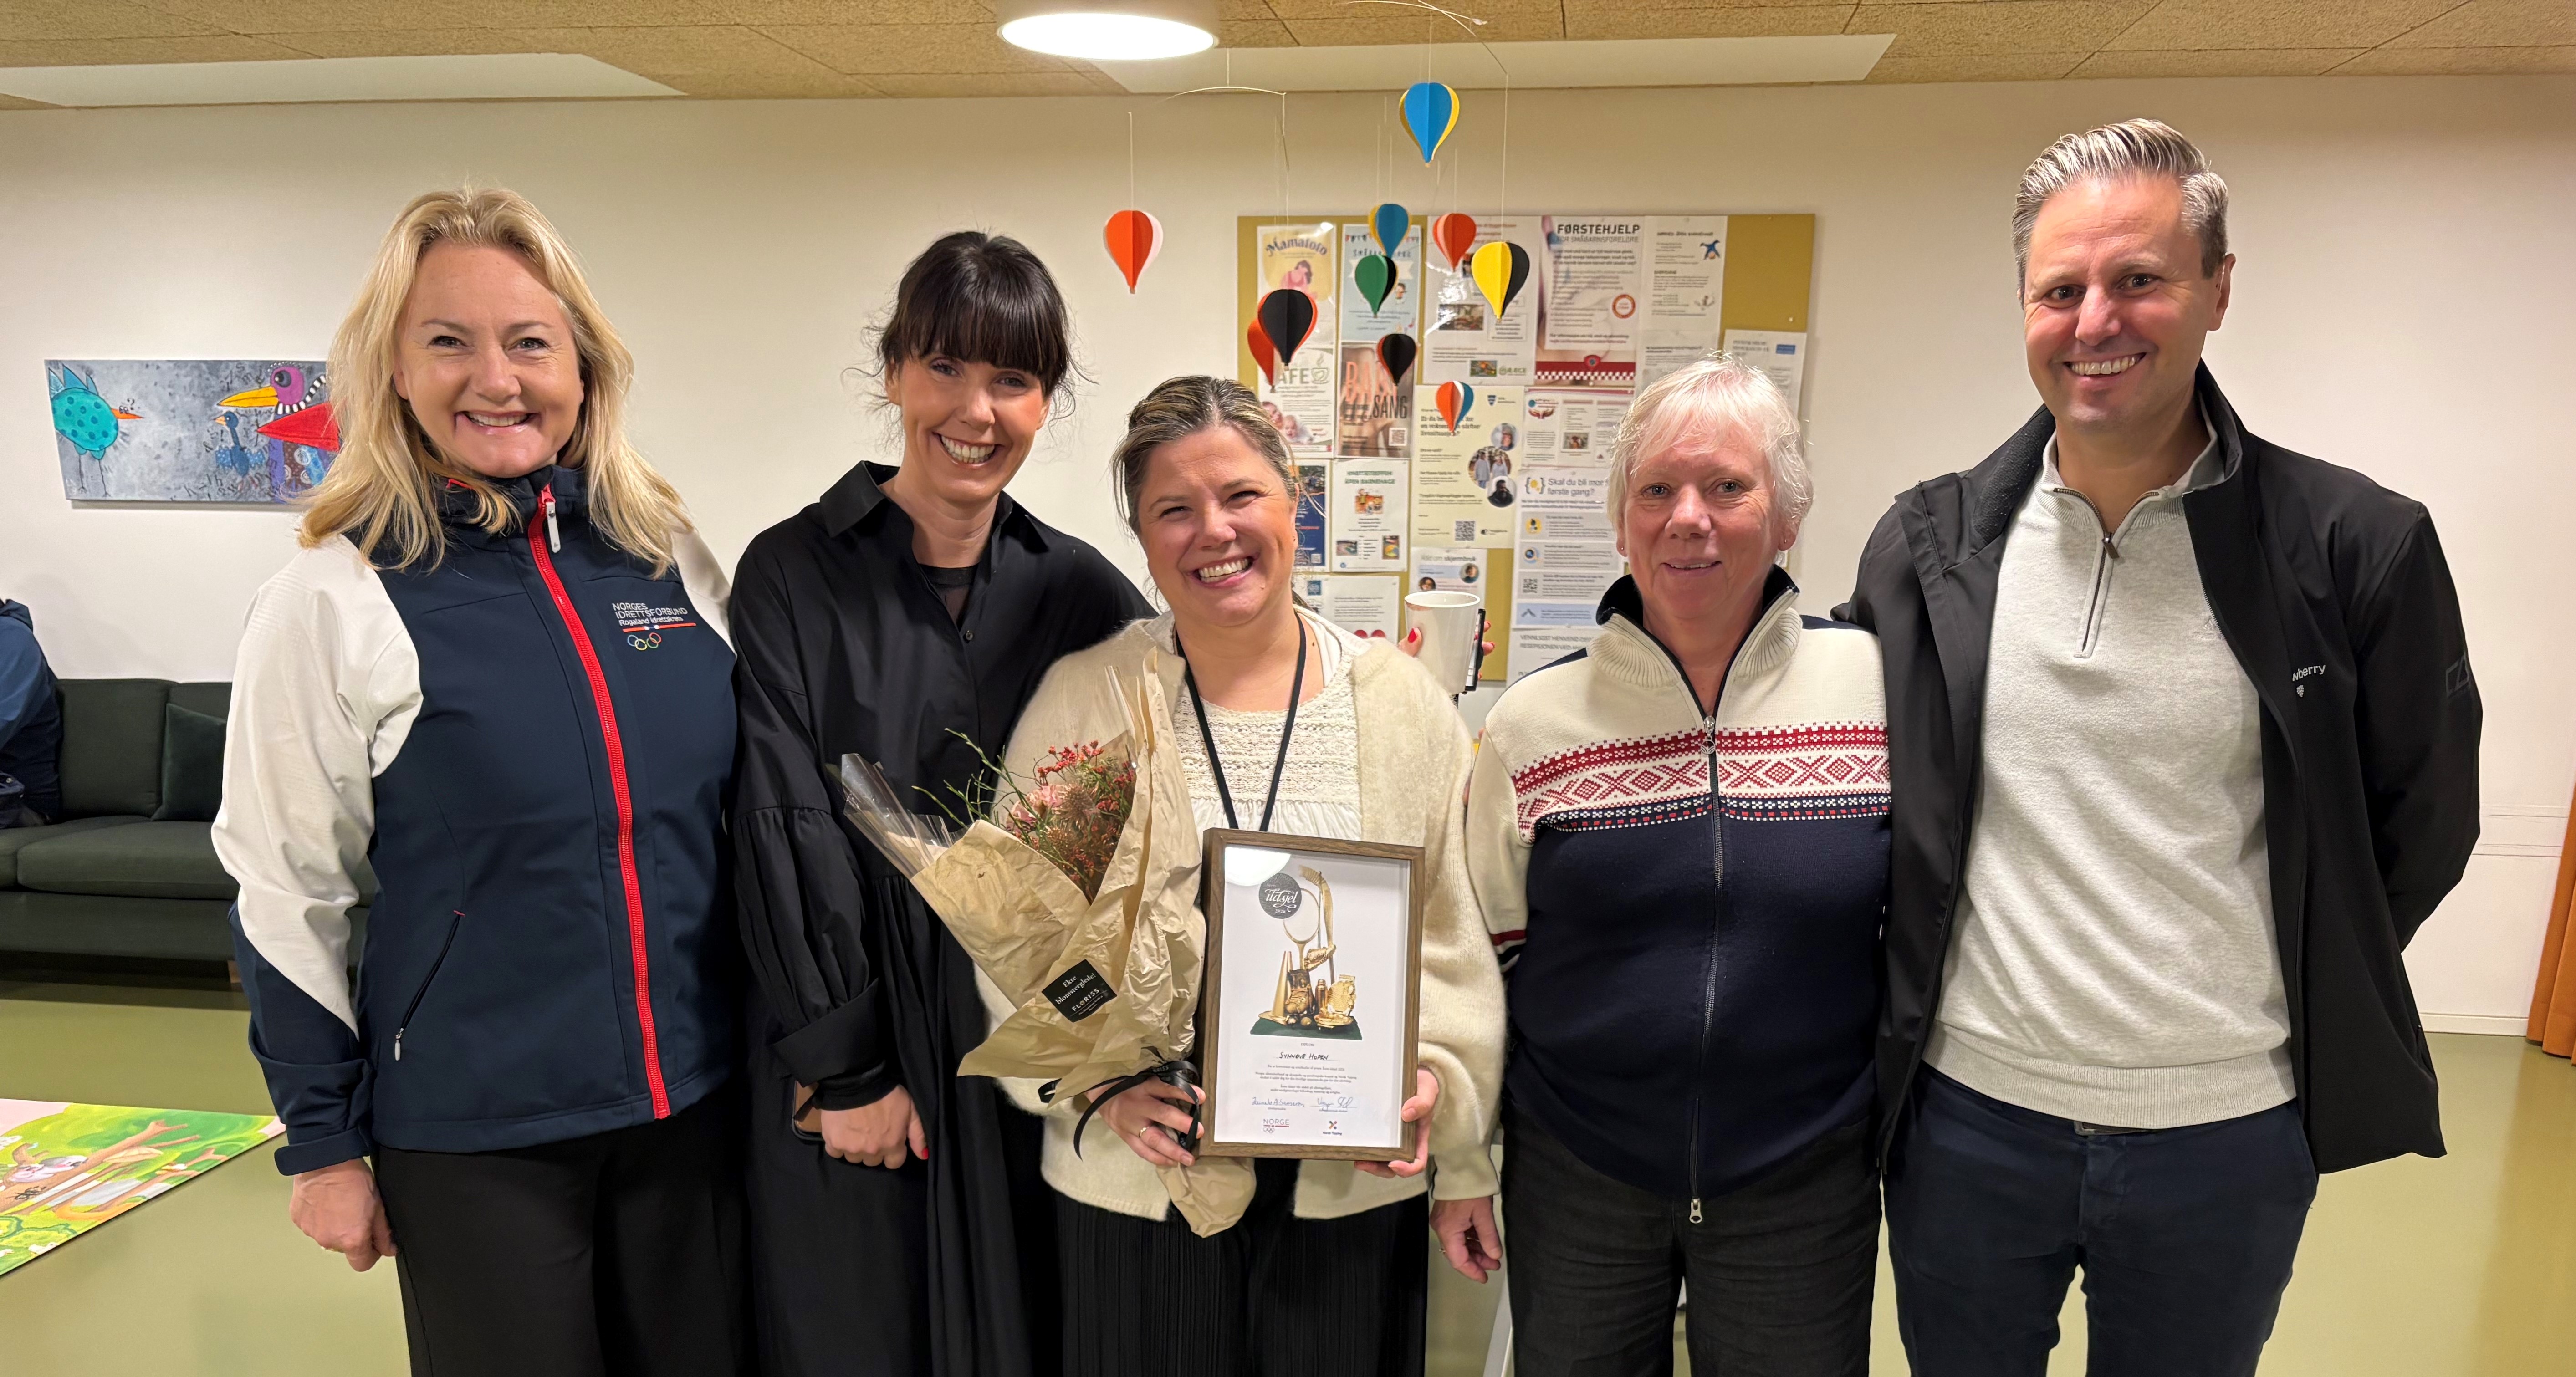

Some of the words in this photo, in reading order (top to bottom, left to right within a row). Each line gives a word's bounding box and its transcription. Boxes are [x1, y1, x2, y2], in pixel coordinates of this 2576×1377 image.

[1557, 224, 1640, 234] FØRSTEHJELP
[1266, 236, 1328, 257] Mamatoto
[1372, 395, 1408, 419] SANG
[612, 602, 648, 611] NORGES
[615, 607, 688, 619] IDRETTSFORBUND
[618, 618, 649, 626] Rogaland
[1265, 888, 1298, 913] ildsjel
[1055, 973, 1096, 1005] blomsterglede!
[1062, 976, 1077, 988] Ekte
[1072, 988, 1100, 1012] FLORISS
